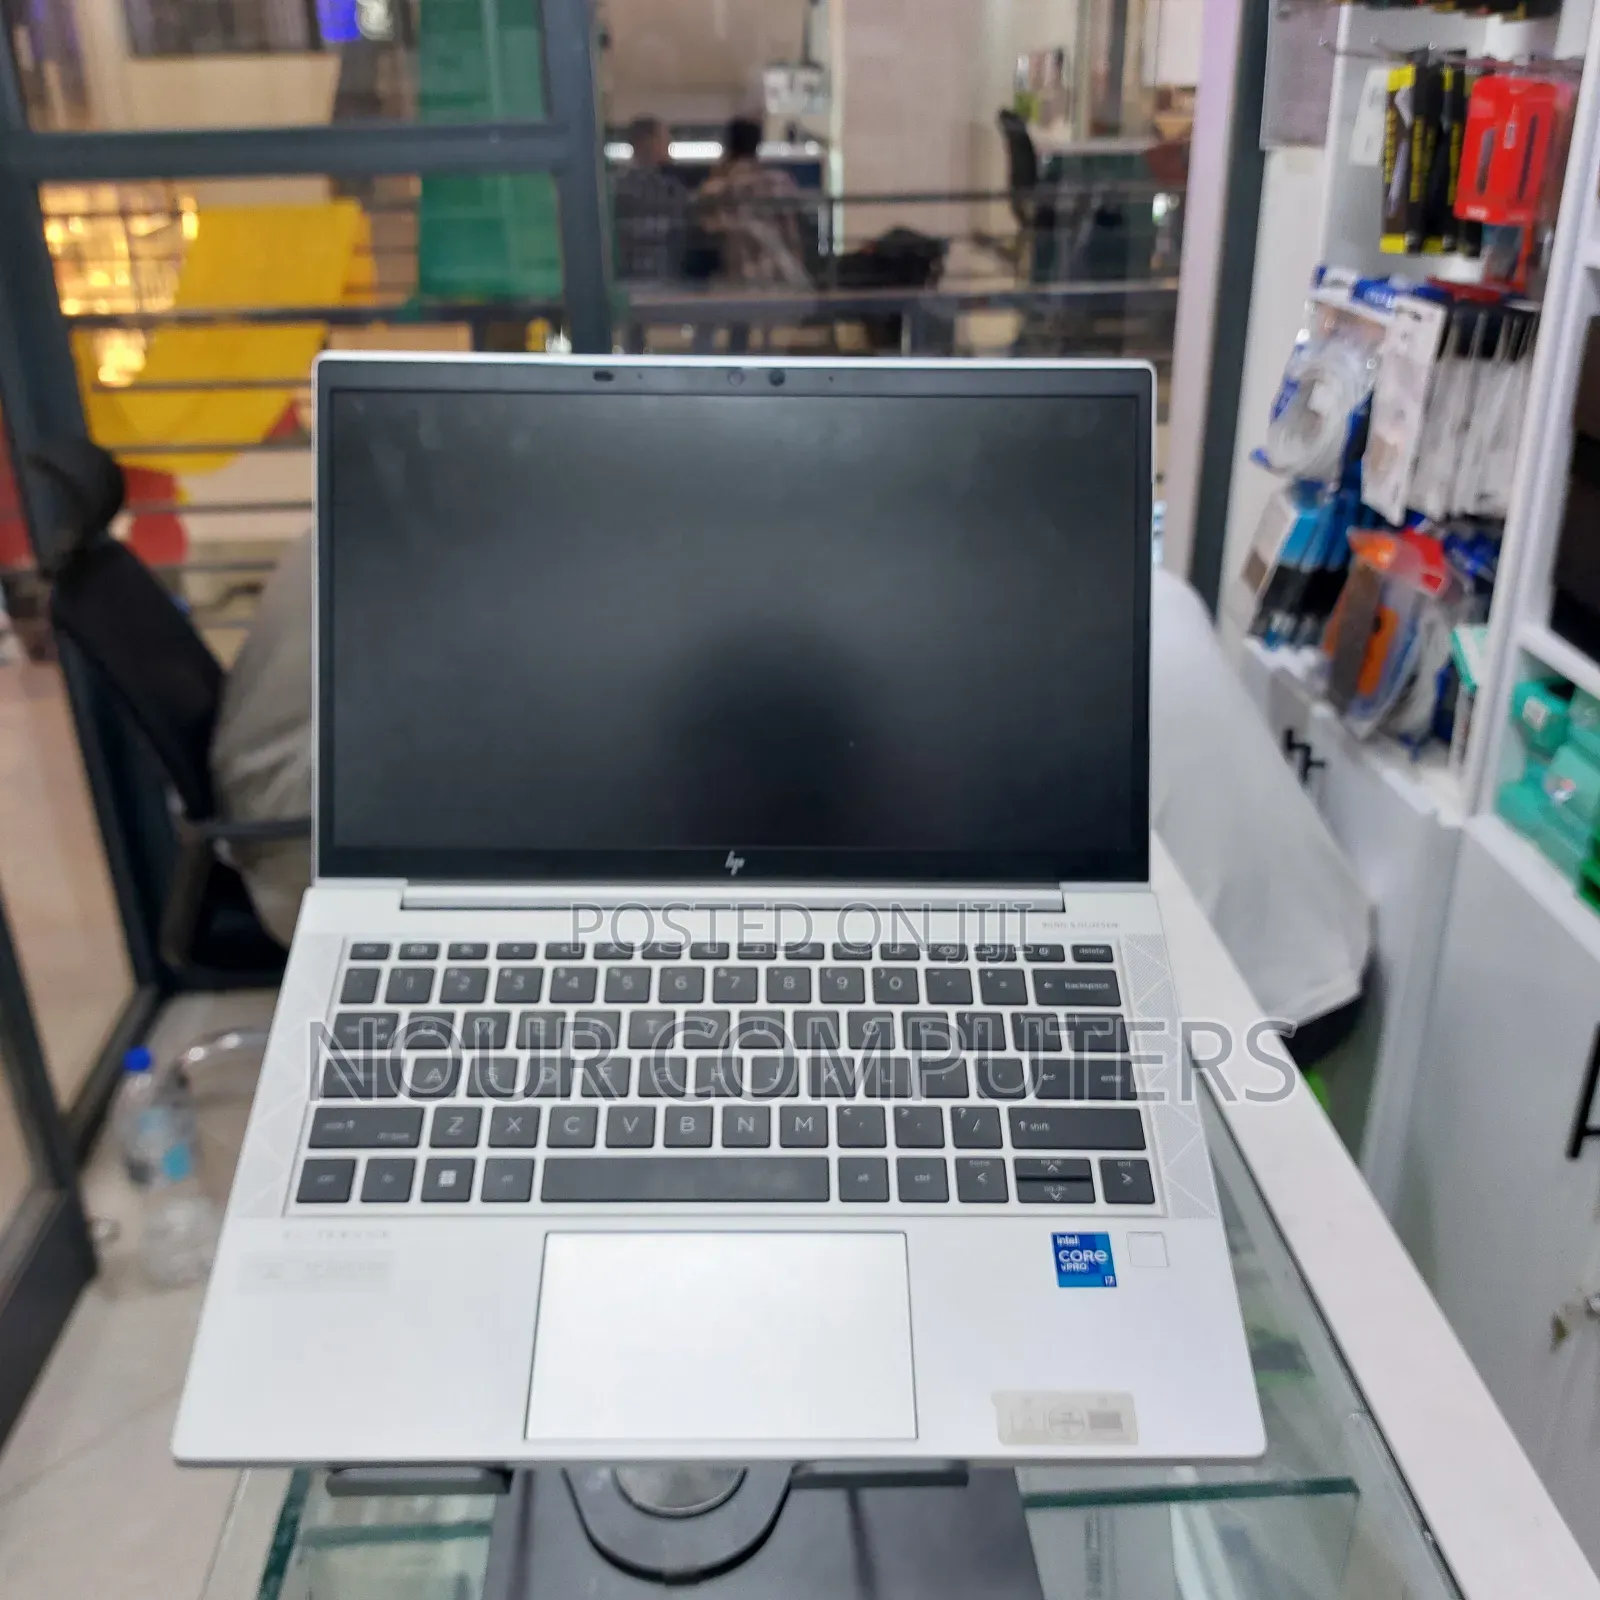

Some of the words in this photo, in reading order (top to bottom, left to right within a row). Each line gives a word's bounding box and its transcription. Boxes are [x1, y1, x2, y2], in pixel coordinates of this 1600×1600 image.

[725, 850, 745, 876] hp
[674, 975, 688, 991] 6
[731, 976, 741, 989] 7
[783, 976, 796, 990] 8
[836, 976, 848, 990] 9
[1064, 980, 1109, 990] backspace
[645, 1019, 658, 1034] T
[424, 1067, 443, 1084] A
[1101, 1074, 1121, 1083] enter
[447, 1116, 464, 1135] Z
[506, 1116, 523, 1133] X
[563, 1116, 580, 1134] C
[623, 1116, 639, 1134] V
[680, 1116, 695, 1134] B
[737, 1116, 755, 1133] N
[795, 1116, 813, 1132] M
[1030, 1122, 1049, 1132] shift
[1056, 1234, 1079, 1247] intel
